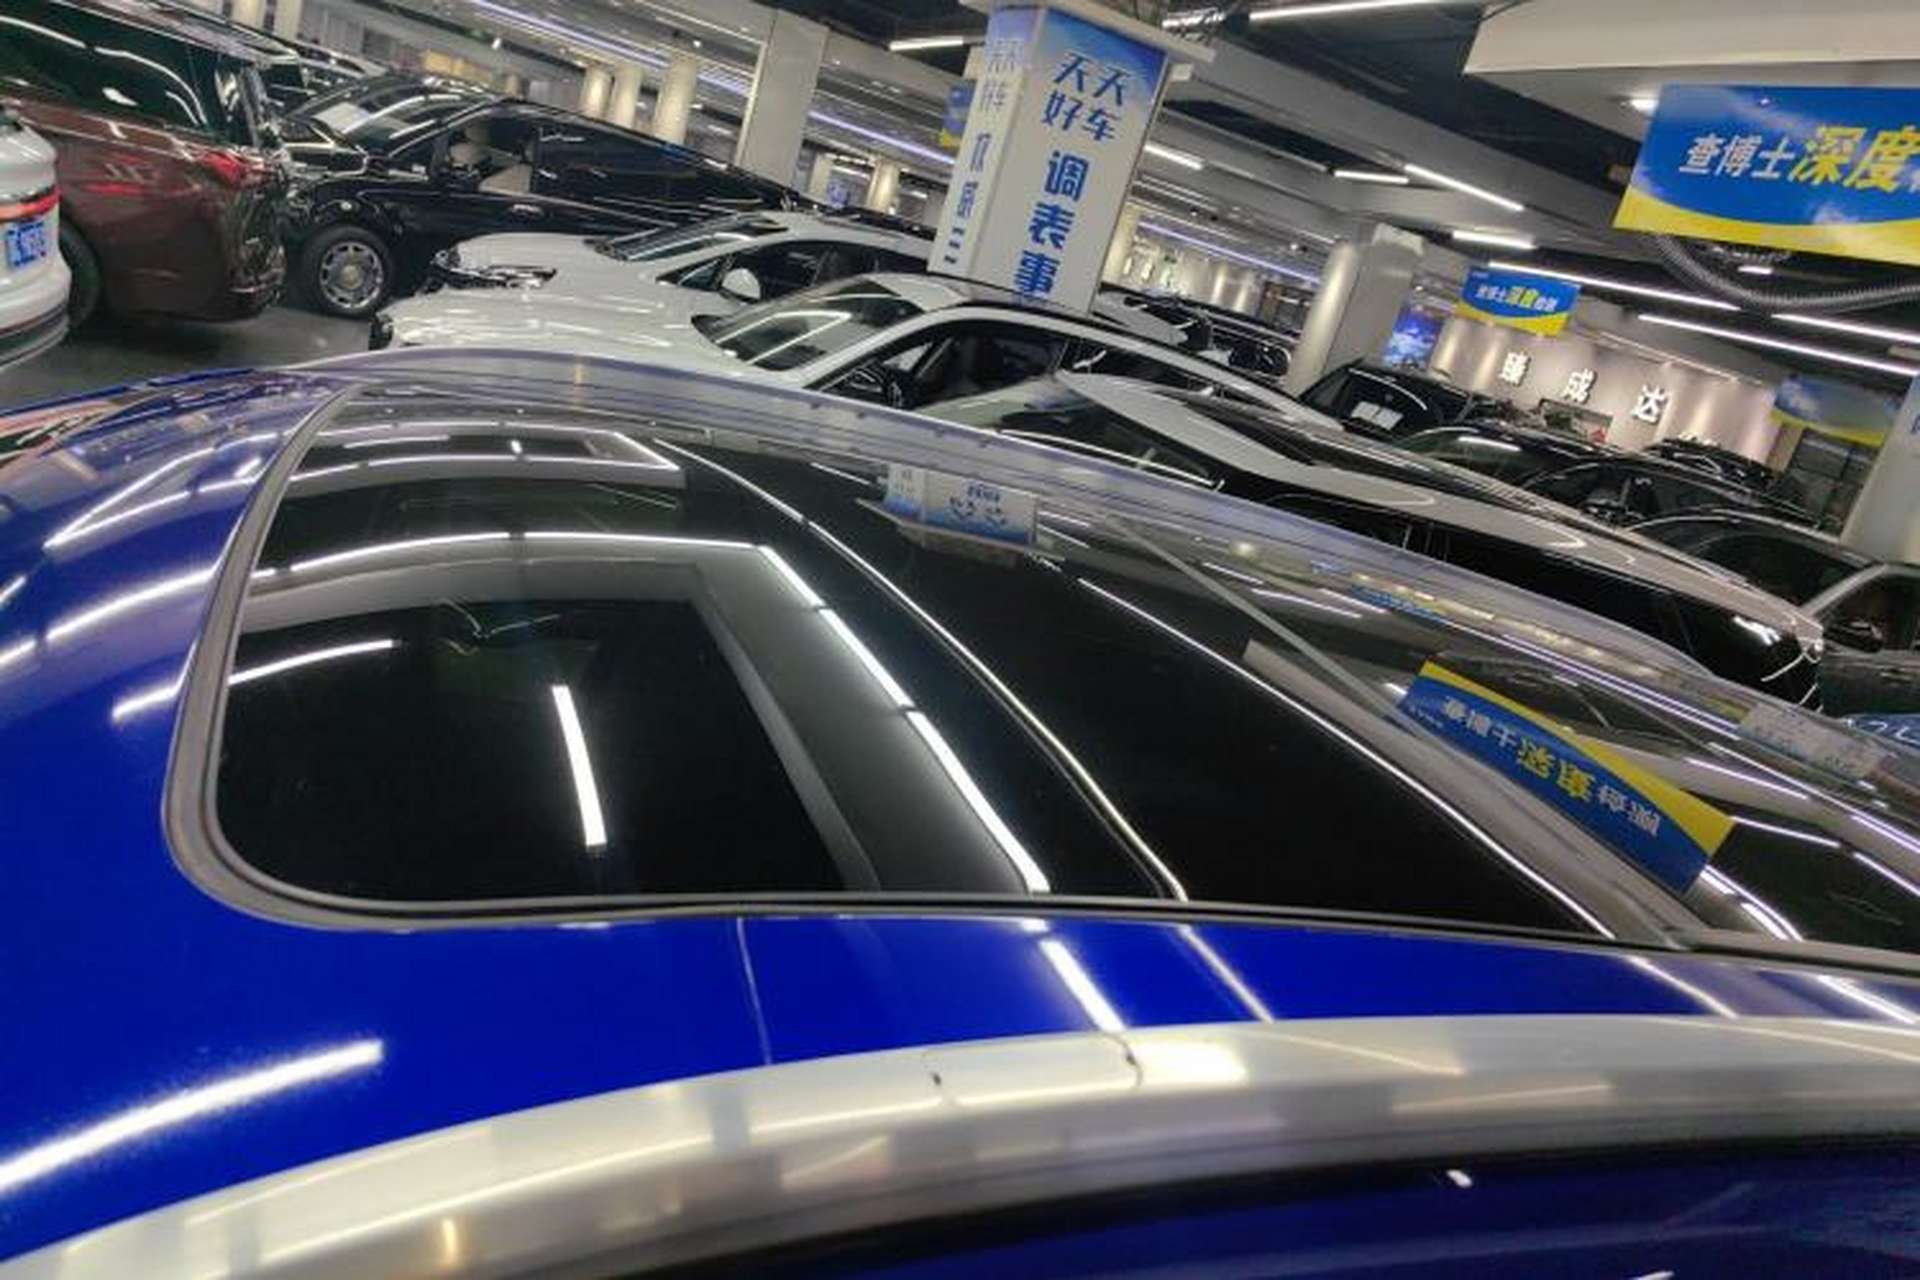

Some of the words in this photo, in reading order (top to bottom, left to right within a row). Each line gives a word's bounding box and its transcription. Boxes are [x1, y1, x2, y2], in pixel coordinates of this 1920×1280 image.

[1678, 124, 1920, 194] 查博士深度
[1013, 150, 1090, 300] 调表事
